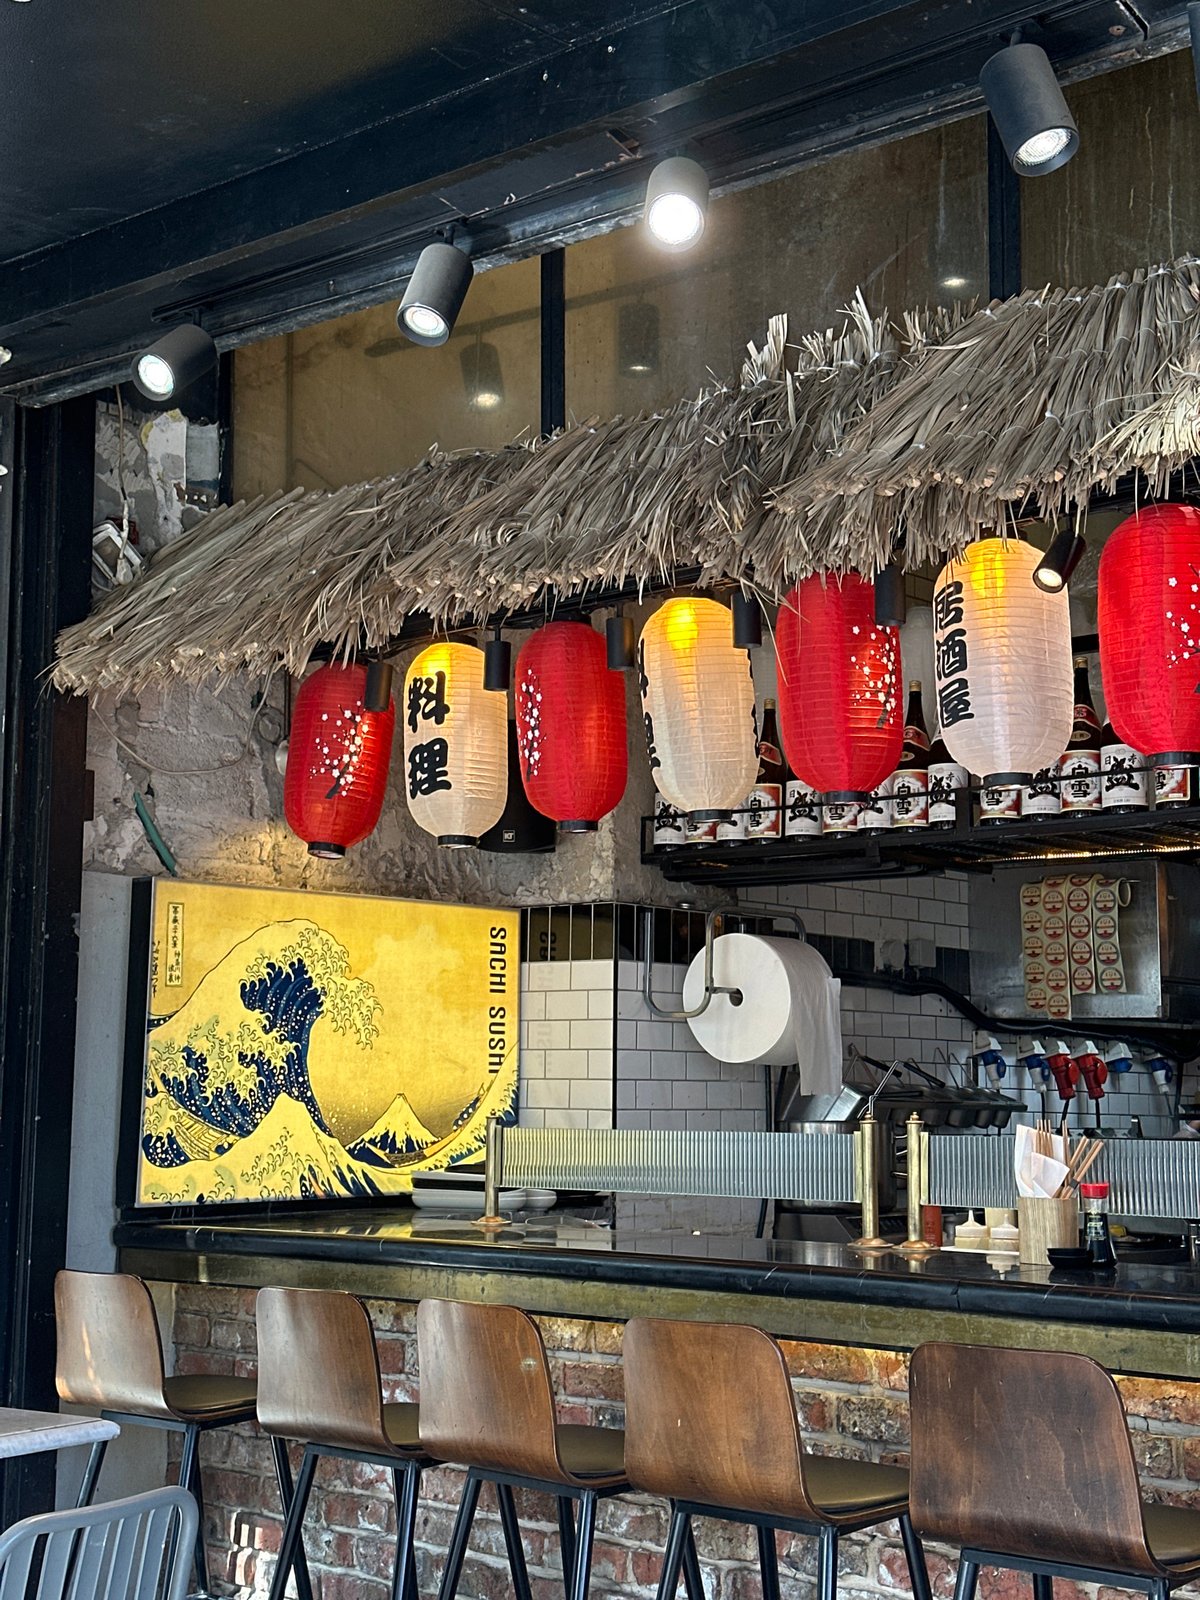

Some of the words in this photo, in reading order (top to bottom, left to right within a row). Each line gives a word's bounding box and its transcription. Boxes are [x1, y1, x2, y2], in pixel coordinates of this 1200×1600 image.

[934, 581, 974, 728] 居酒屋
[408, 671, 452, 799] 料理
[829, 804, 845, 820] 雪
[897, 783, 912, 815] 白雪
[986, 790, 1001, 806] 雪
[489, 927, 506, 993] SACHI
[488, 1007, 506, 1074] SUSHI
